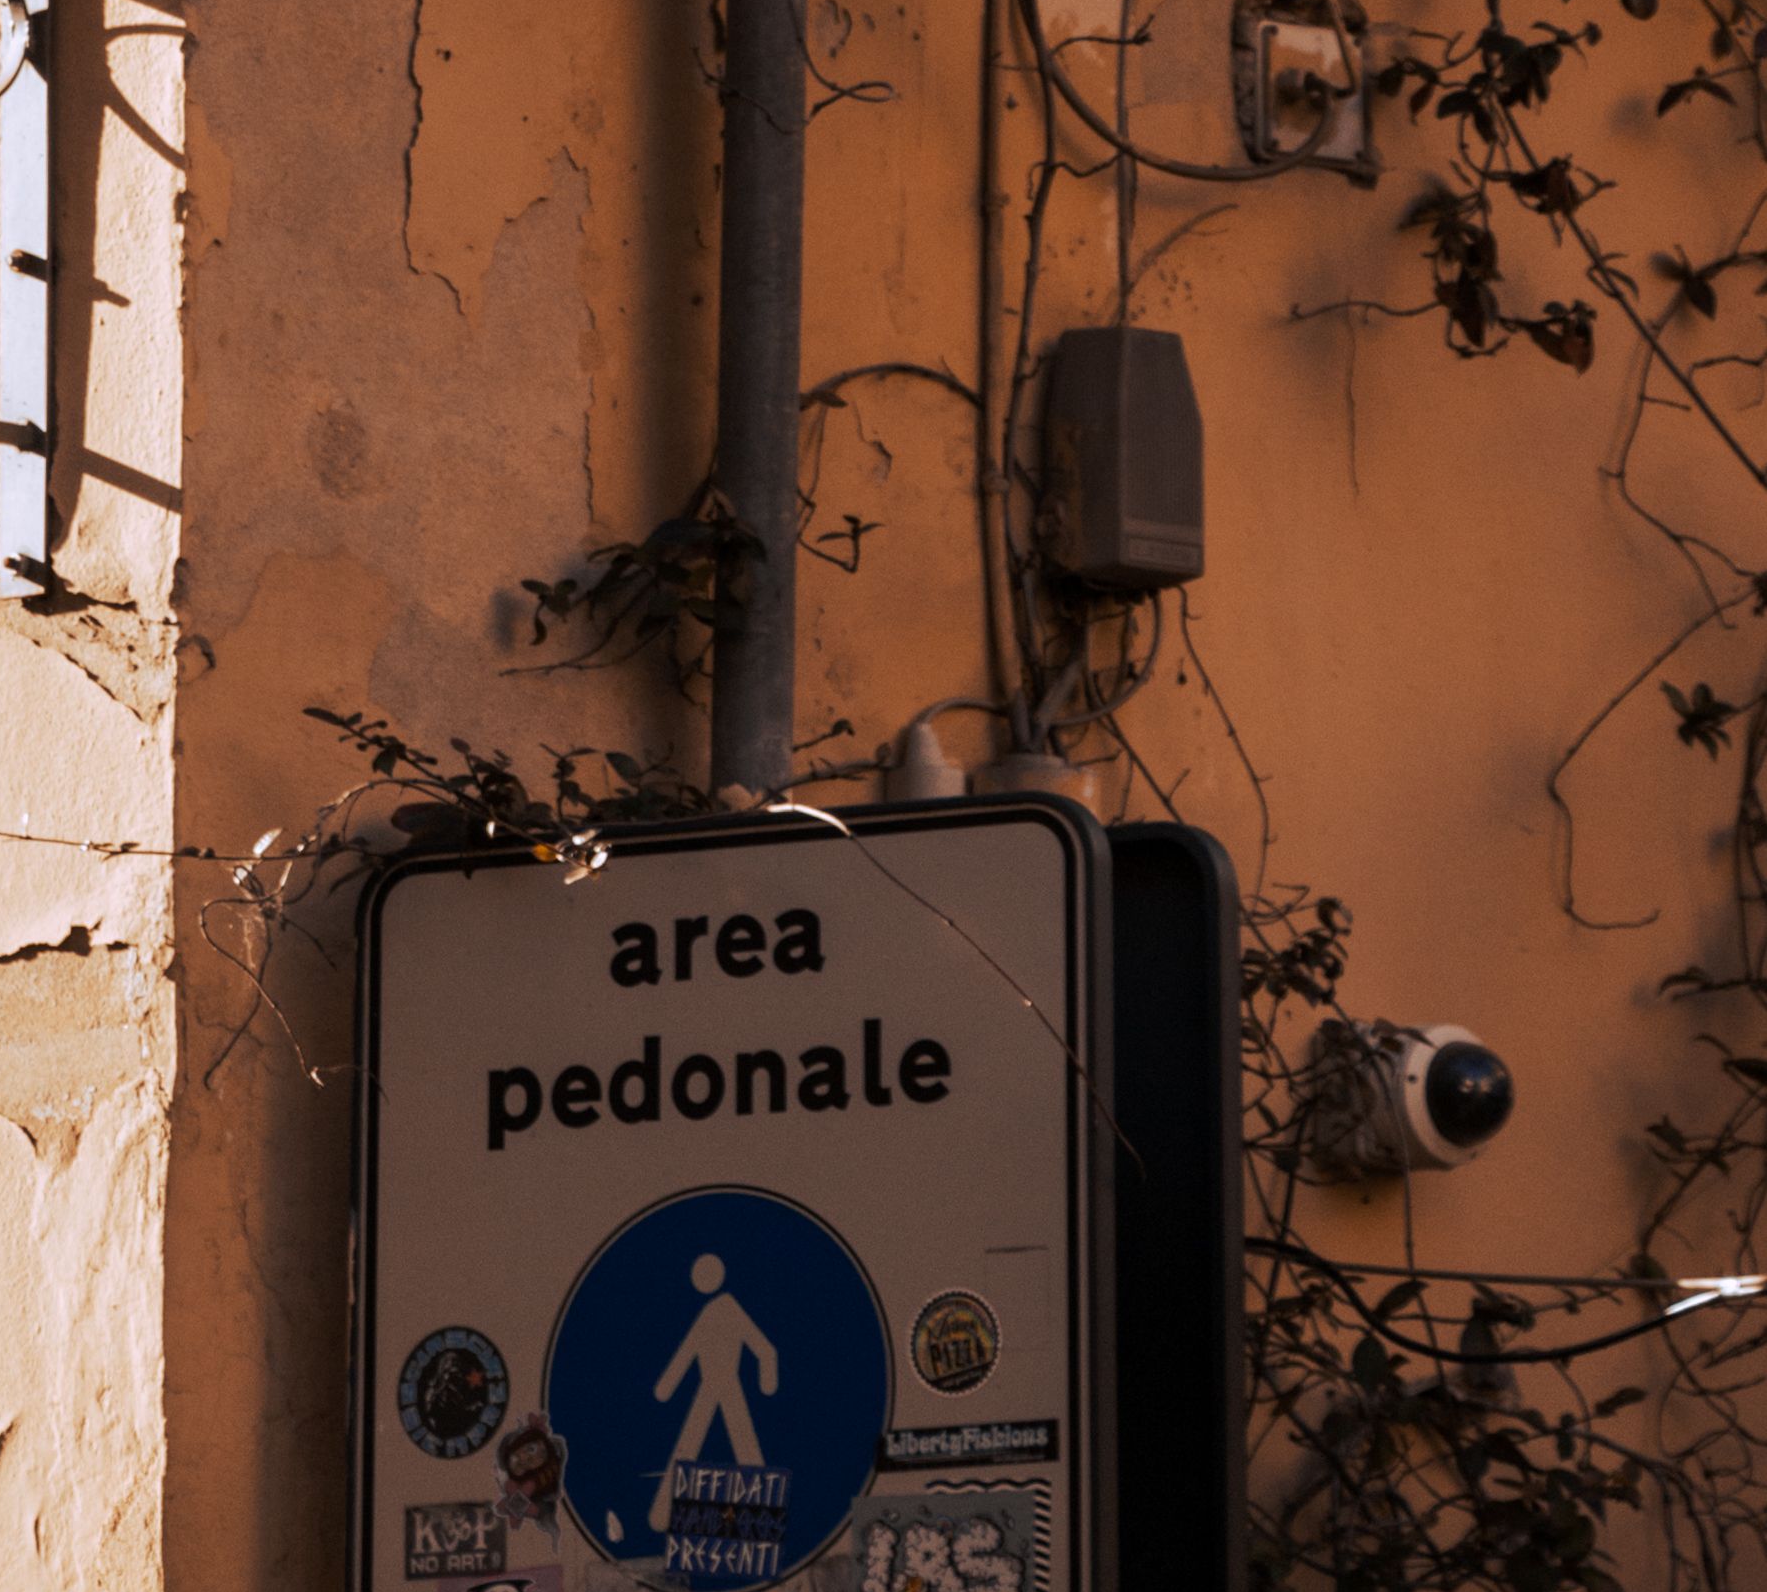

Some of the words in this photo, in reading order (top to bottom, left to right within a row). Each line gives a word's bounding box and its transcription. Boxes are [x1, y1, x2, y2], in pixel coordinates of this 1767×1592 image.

[609, 908, 826, 988] area
[487, 1017, 952, 1151] pedonale
[674, 1465, 787, 1508] DIFFIDATI
[410, 1554, 440, 1575] NO
[665, 1534, 780, 1578] PRESENTI
